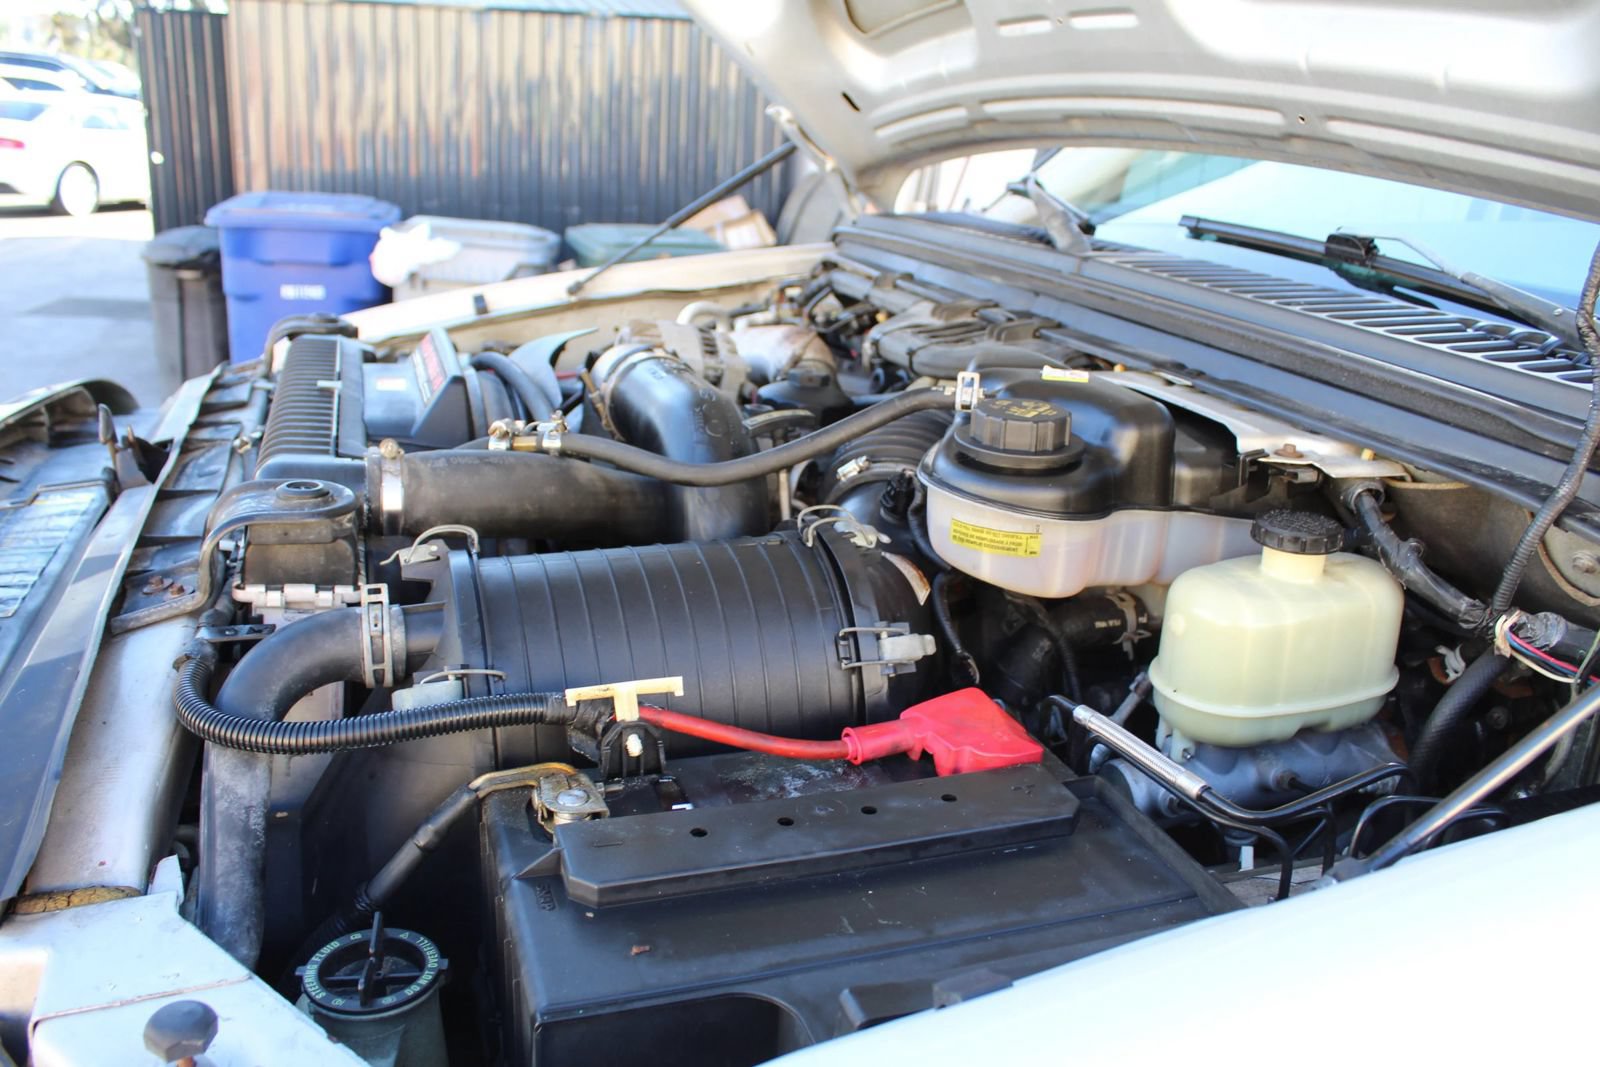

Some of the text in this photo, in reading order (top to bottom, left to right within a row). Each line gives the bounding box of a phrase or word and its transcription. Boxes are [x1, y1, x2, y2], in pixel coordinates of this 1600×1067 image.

[303, 941, 340, 999] STEERING FLUID
[405, 936, 438, 996] DO NOT OVERFILL
